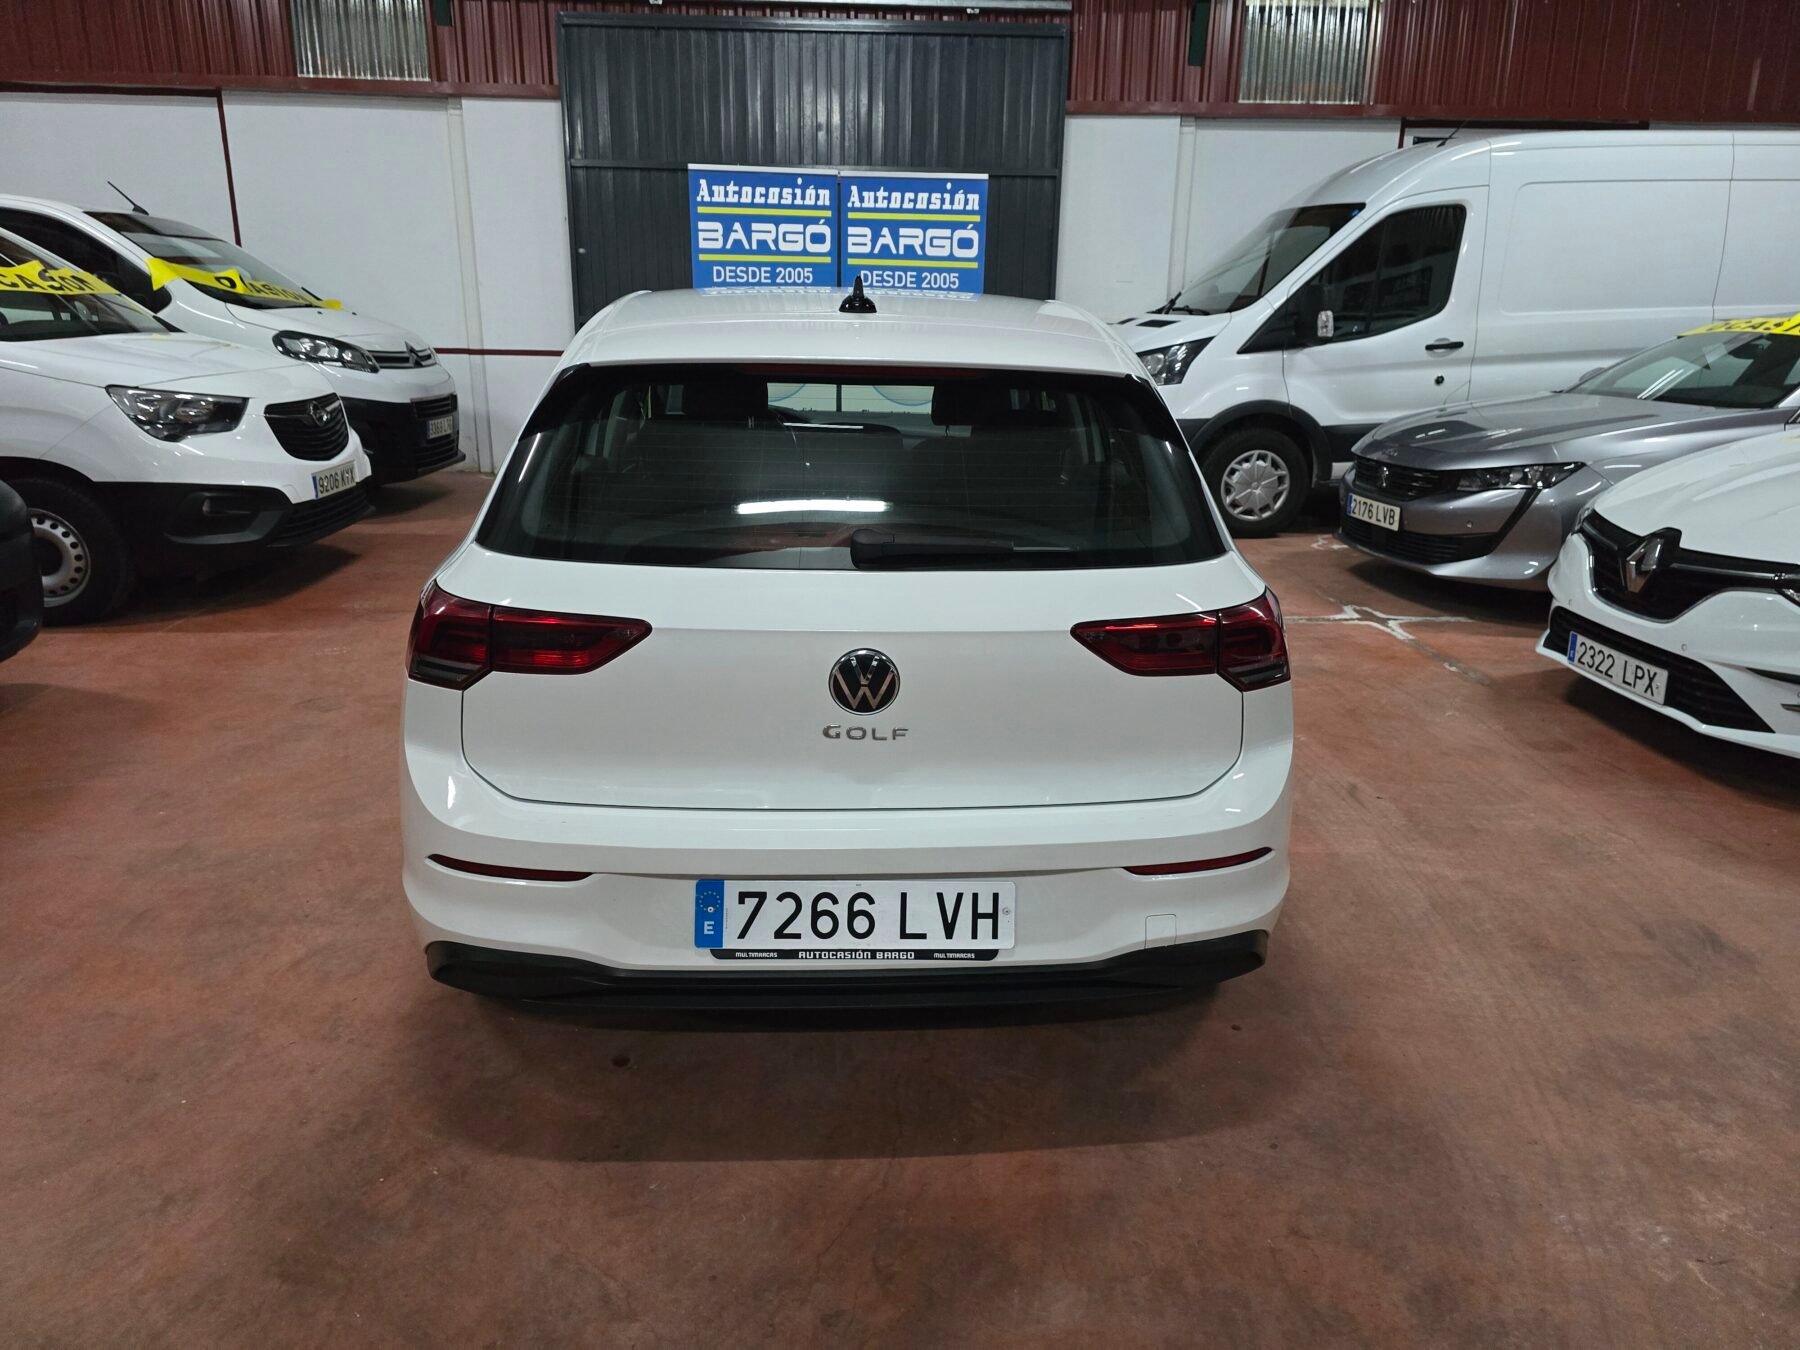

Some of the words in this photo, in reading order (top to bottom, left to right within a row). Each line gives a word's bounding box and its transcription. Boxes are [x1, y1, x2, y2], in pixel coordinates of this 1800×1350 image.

[696, 177, 831, 206] Autocasión
[847, 182, 980, 211] Autocasión
[697, 218, 832, 253] BARGÓ
[847, 224, 979, 258] BARGÓ
[712, 265, 772, 283] DESDE
[775, 266, 814, 284] 2005
[860, 270, 917, 288] DESDE
[921, 271, 960, 289] 2005
[318, 473, 340, 495] 9206
[340, 466, 356, 488] KYX
[1351, 498, 1374, 519] 2176
[1375, 503, 1396, 526] LVB
[1577, 641, 1616, 679] 2322
[1622, 660, 1658, 697] LPX
[822, 723, 910, 741] GOLF
[703, 920, 715, 935] E
[736, 891, 876, 940] 7266
[899, 891, 1000, 940] LVH
[798, 950, 872, 959] AUTOCASIÓN
[876, 951, 915, 960] BARGO
